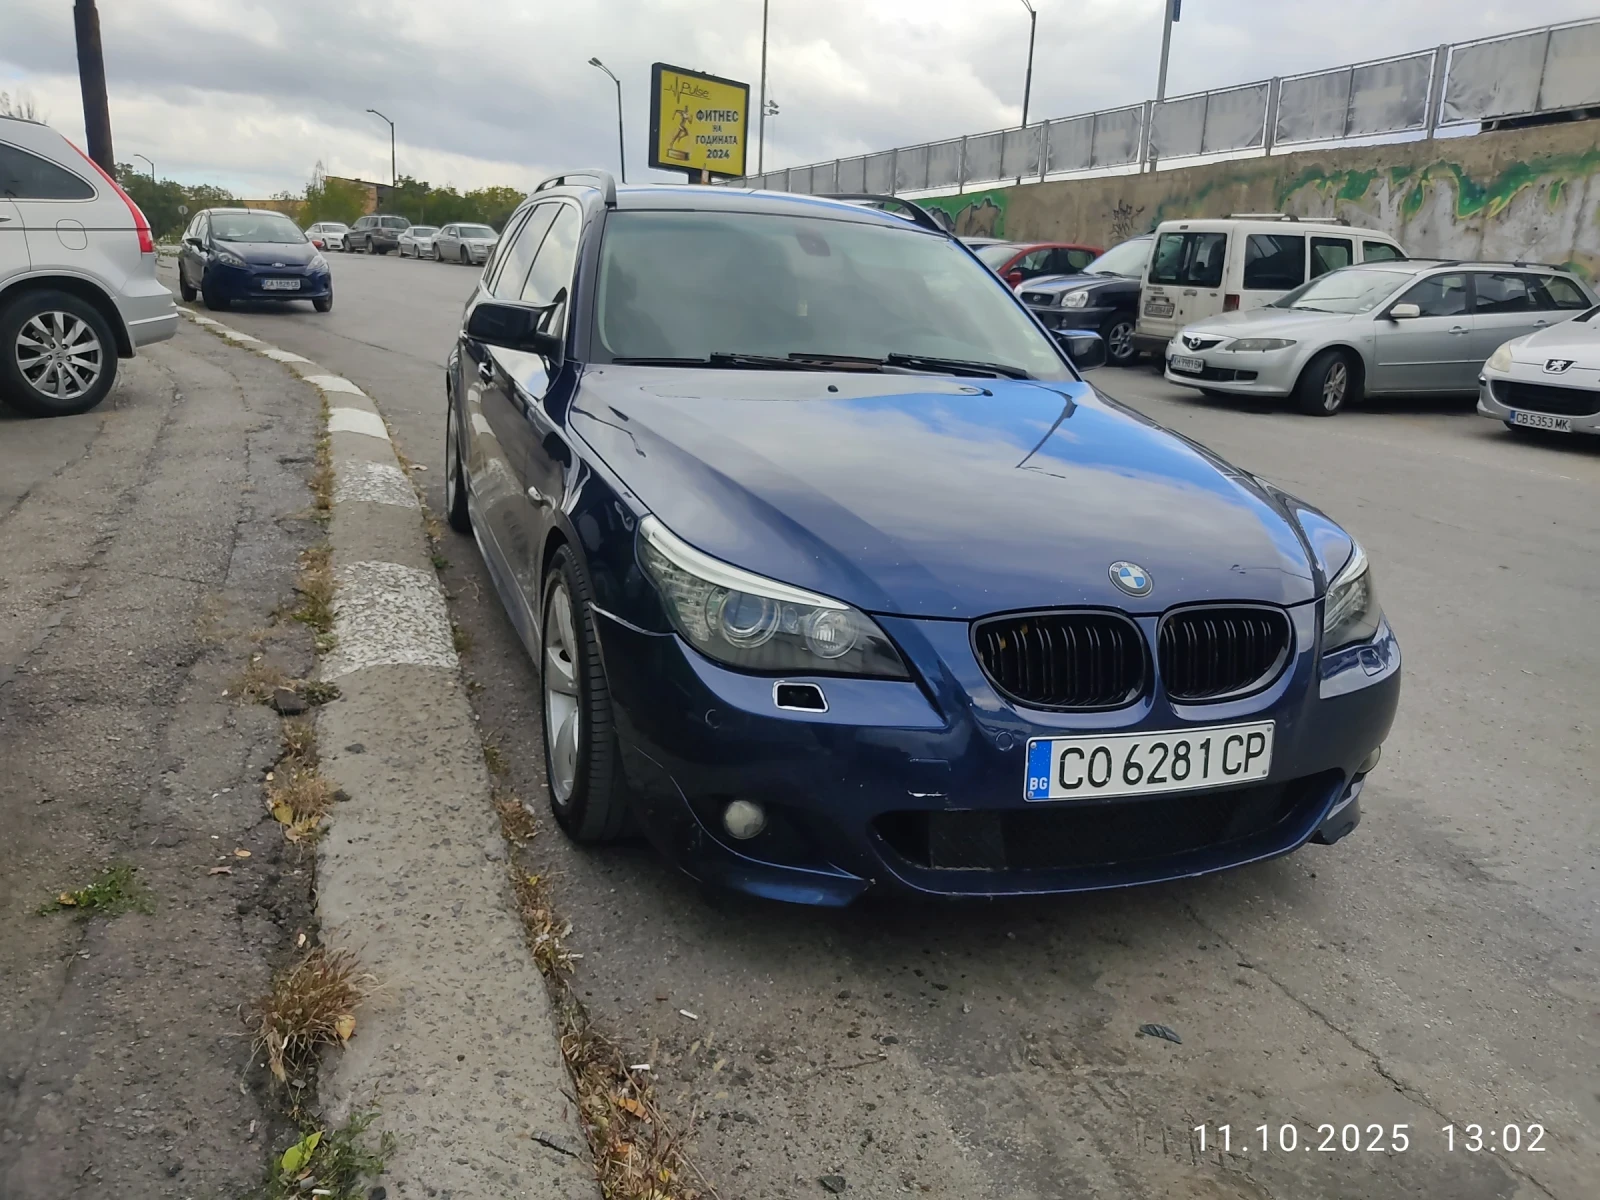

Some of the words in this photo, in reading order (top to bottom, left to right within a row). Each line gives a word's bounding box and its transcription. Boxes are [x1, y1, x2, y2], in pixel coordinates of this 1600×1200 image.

[681, 81, 710, 98] Pulse
[696, 109, 739, 122] ФИТНЕС
[712, 125, 723, 133] НА
[695, 135, 738, 146] ГОДИНАТА
[706, 149, 730, 159] 2024
[1516, 413, 1529, 424] CB
[1530, 415, 1553, 428] 5353
[1555, 419, 1569, 430] MK
[1058, 746, 1112, 790] CO
[1122, 737, 1211, 786] 6281
[1221, 731, 1266, 776] CP
[1029, 777, 1048, 791] BG
